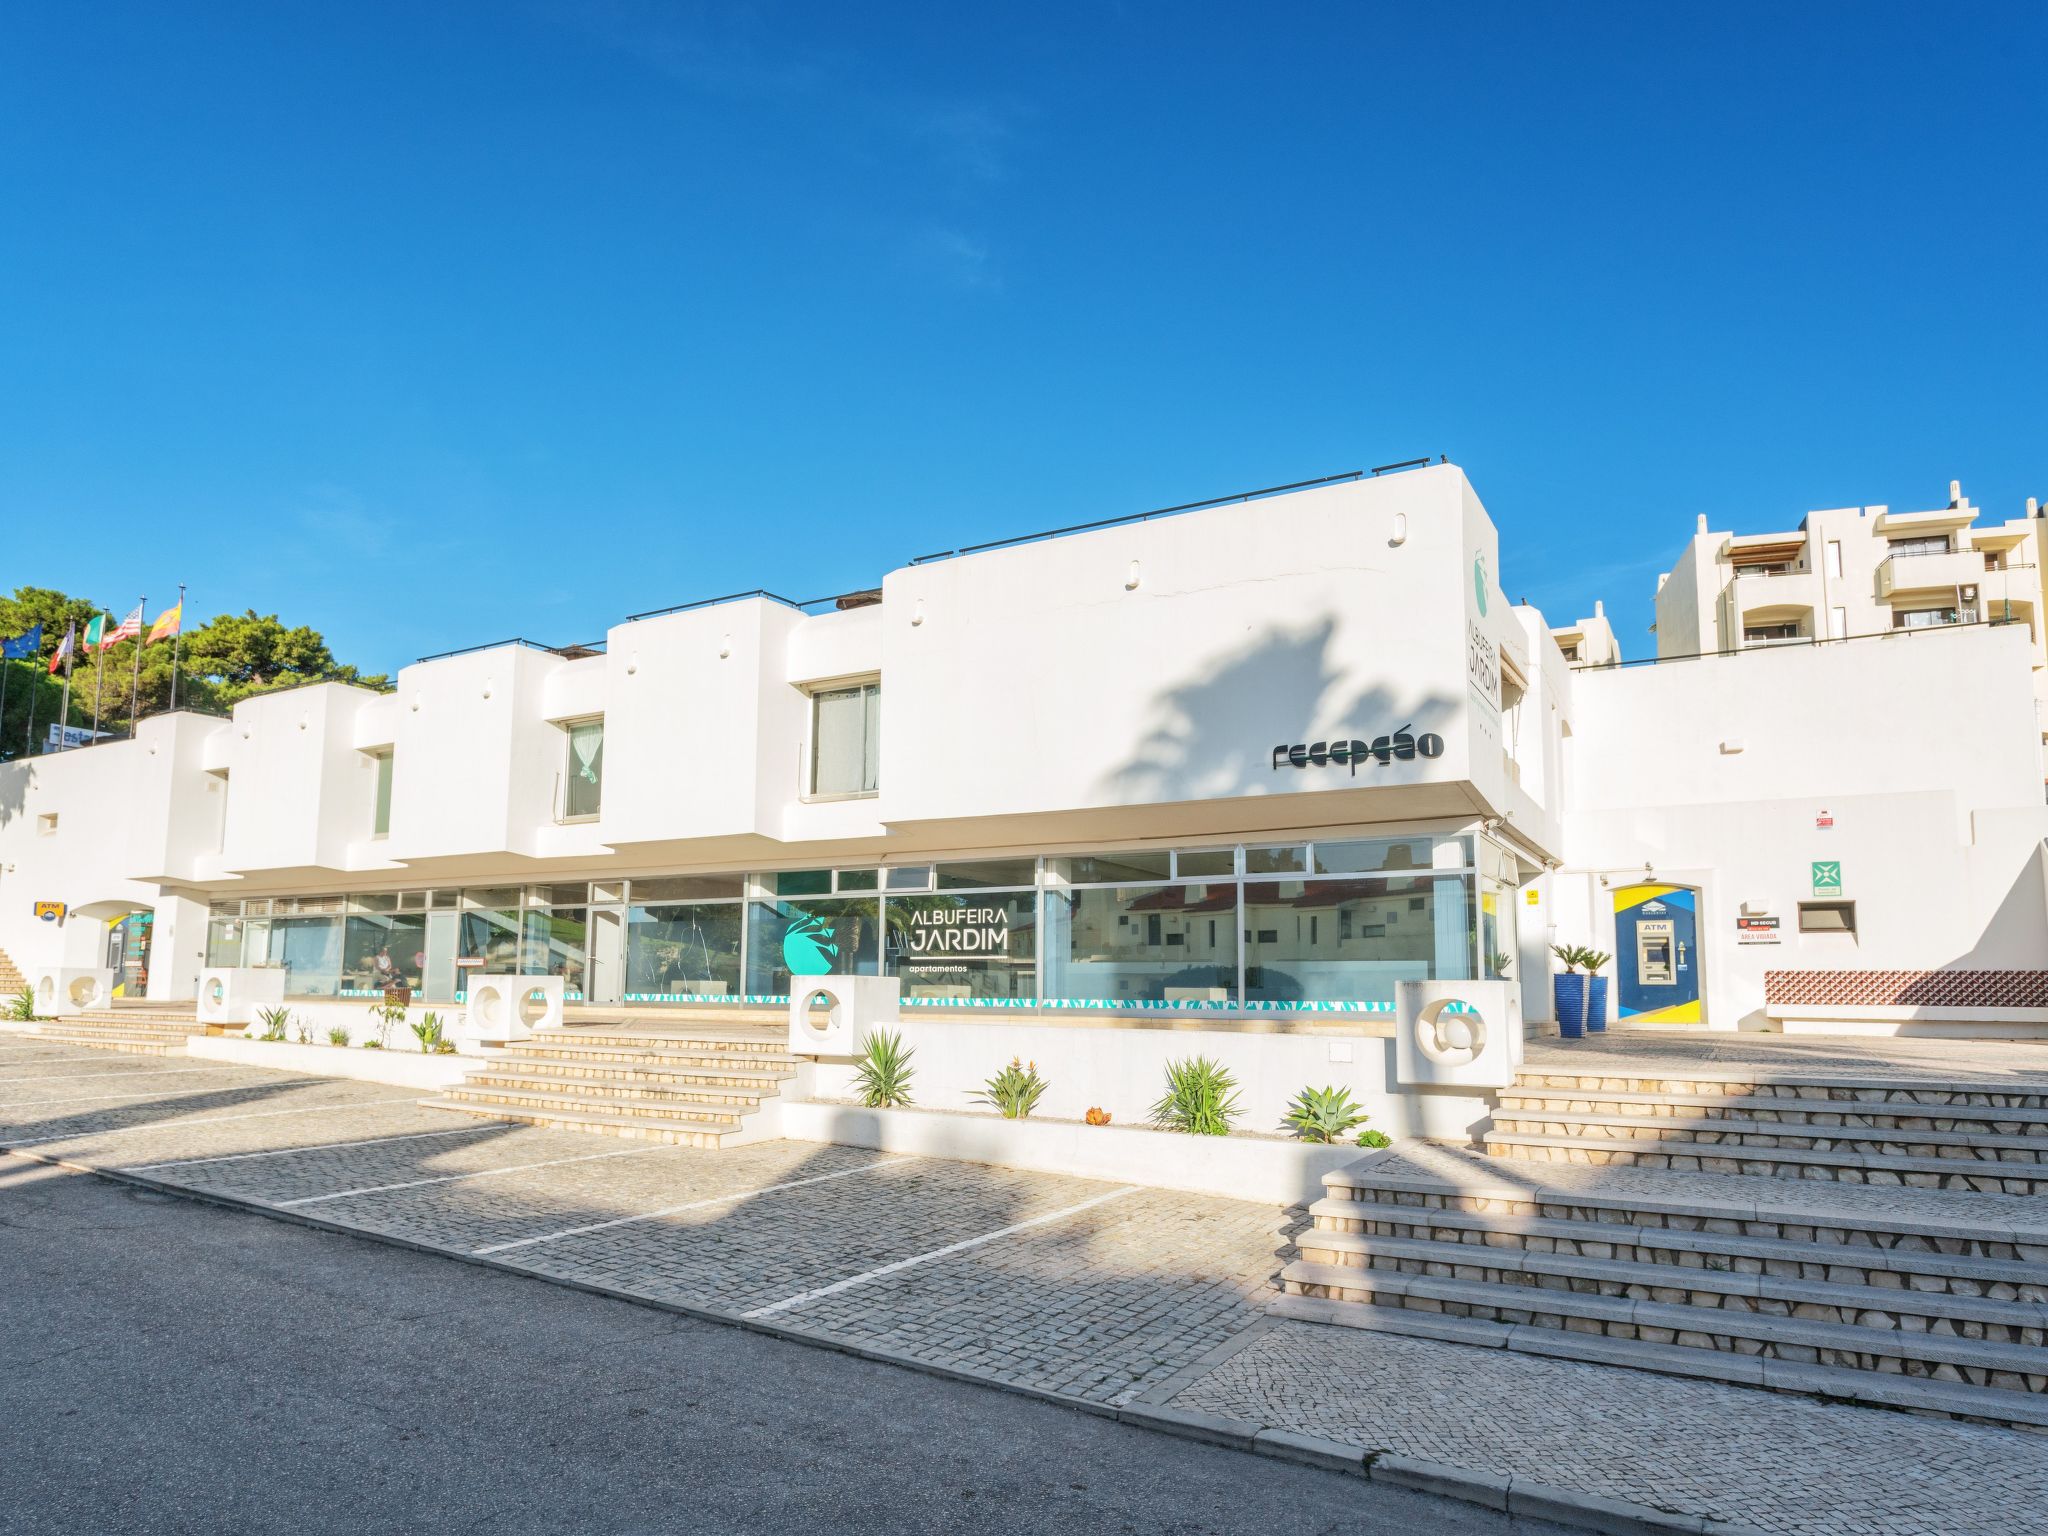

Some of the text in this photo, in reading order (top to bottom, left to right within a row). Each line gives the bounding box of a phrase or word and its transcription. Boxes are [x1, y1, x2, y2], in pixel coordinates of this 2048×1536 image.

[1468, 618, 1496, 668] ALBUFEIRA
[1469, 645, 1498, 702] JARDIM
[910, 908, 1008, 926] ALBUFEIRA
[910, 928, 1008, 951] JARDIM
[909, 964, 968, 974] apartamentos
